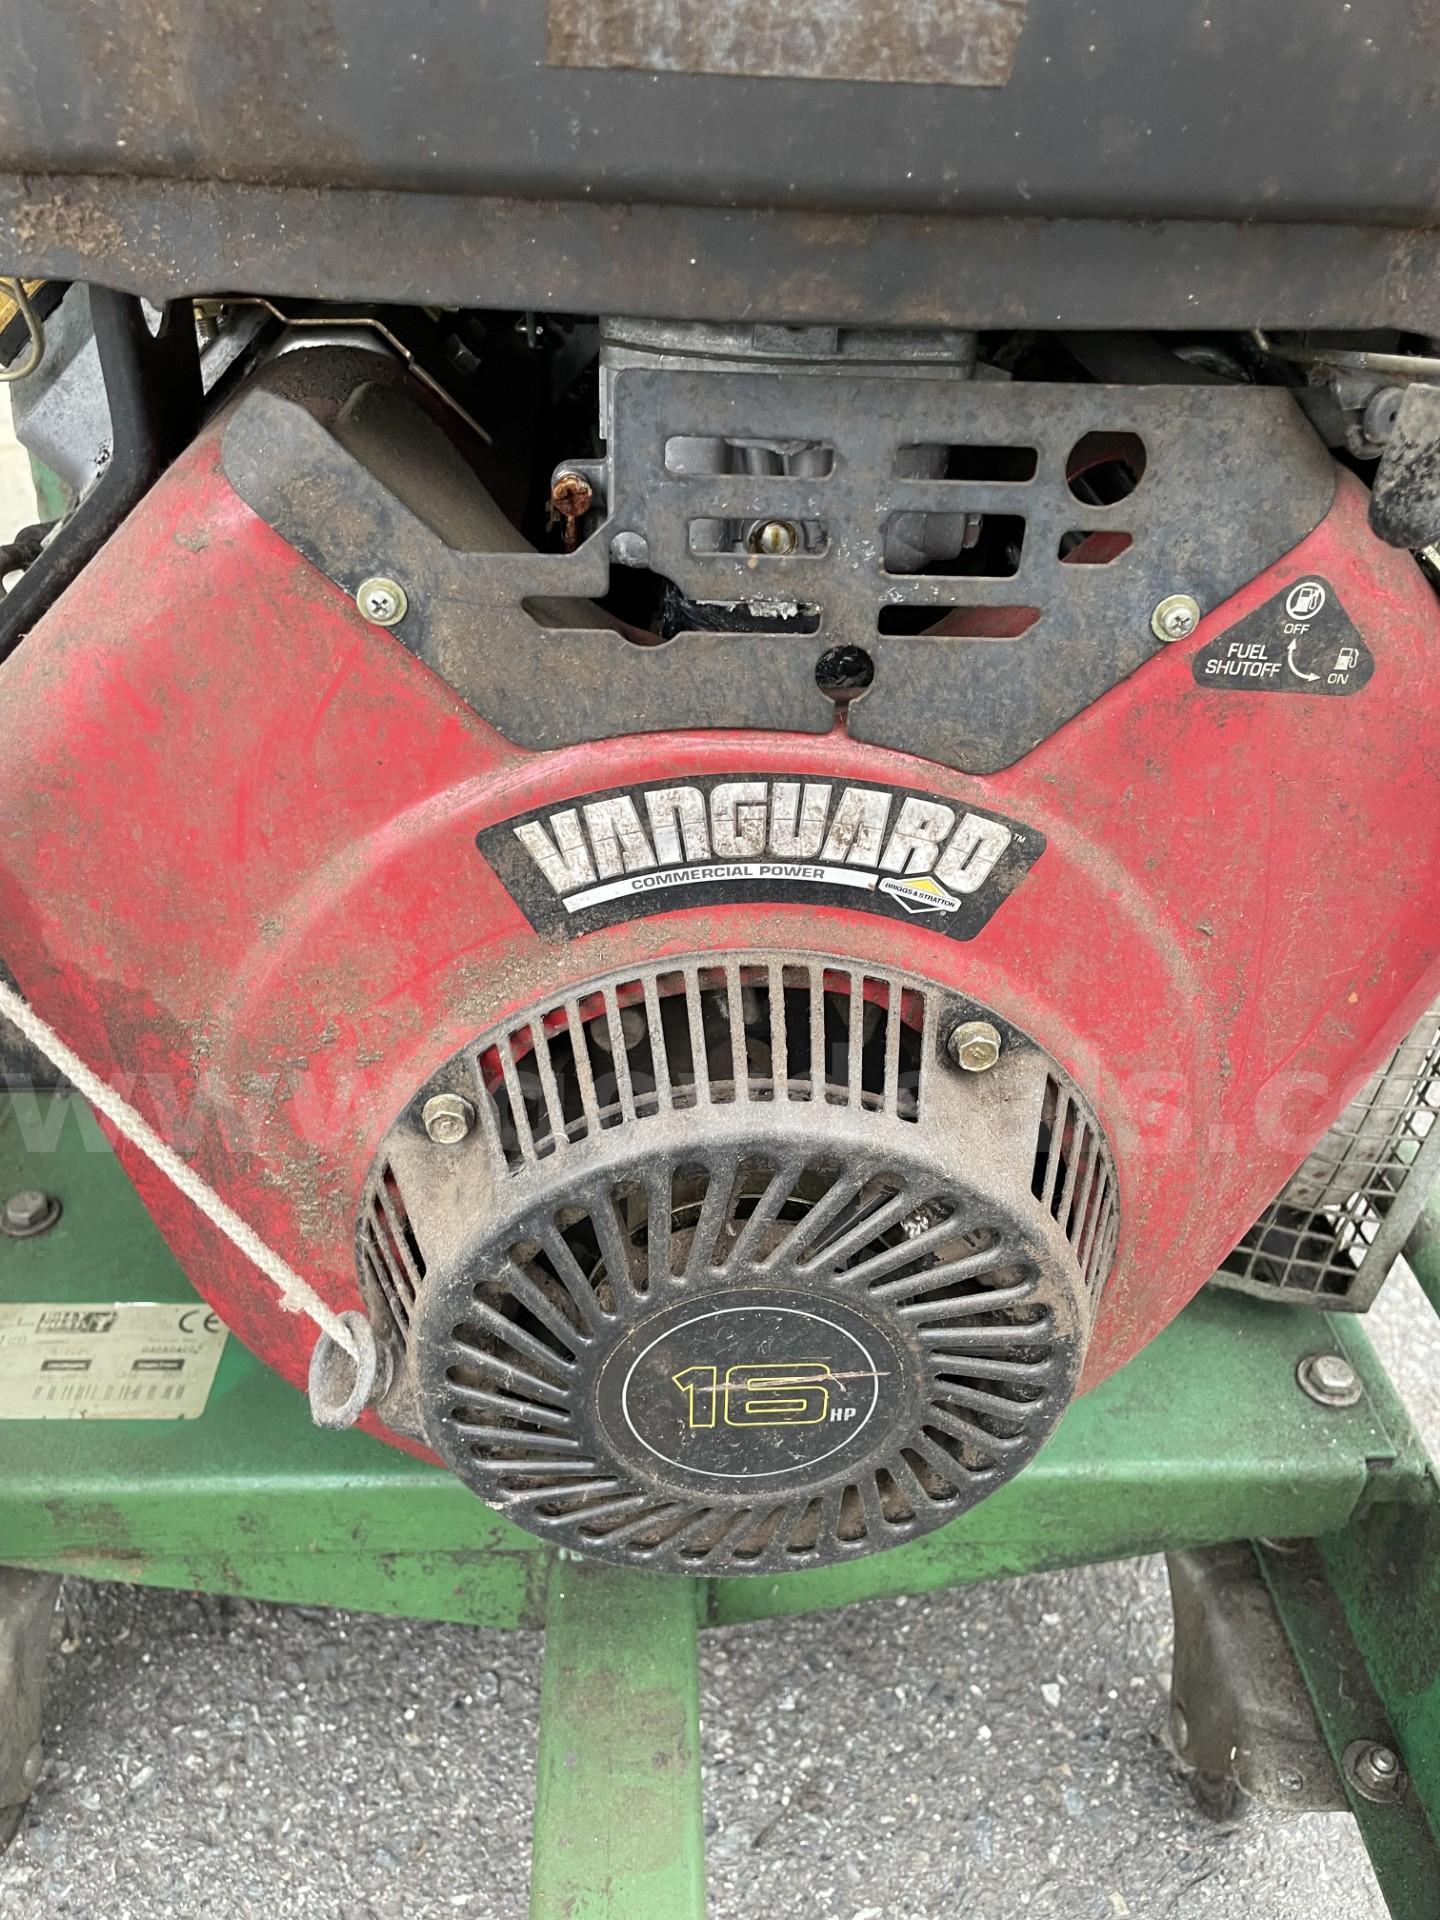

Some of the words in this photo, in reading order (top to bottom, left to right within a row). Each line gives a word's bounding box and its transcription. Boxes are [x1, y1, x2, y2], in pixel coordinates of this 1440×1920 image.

[1283, 623, 1310, 635] OFF
[1227, 642, 1268, 660] FUEL
[1205, 659, 1282, 678] SHUTOFF
[1327, 673, 1349, 685] ON
[512, 781, 1012, 895] VANGUARD
[631, 864, 755, 891] COMMERCIAL
[757, 865, 825, 881] POWER
[884, 882, 913, 896] BRIGGS
[917, 891, 957, 908] STRATTON
[671, 1363, 831, 1428] 16
[829, 1407, 856, 1422] HP
